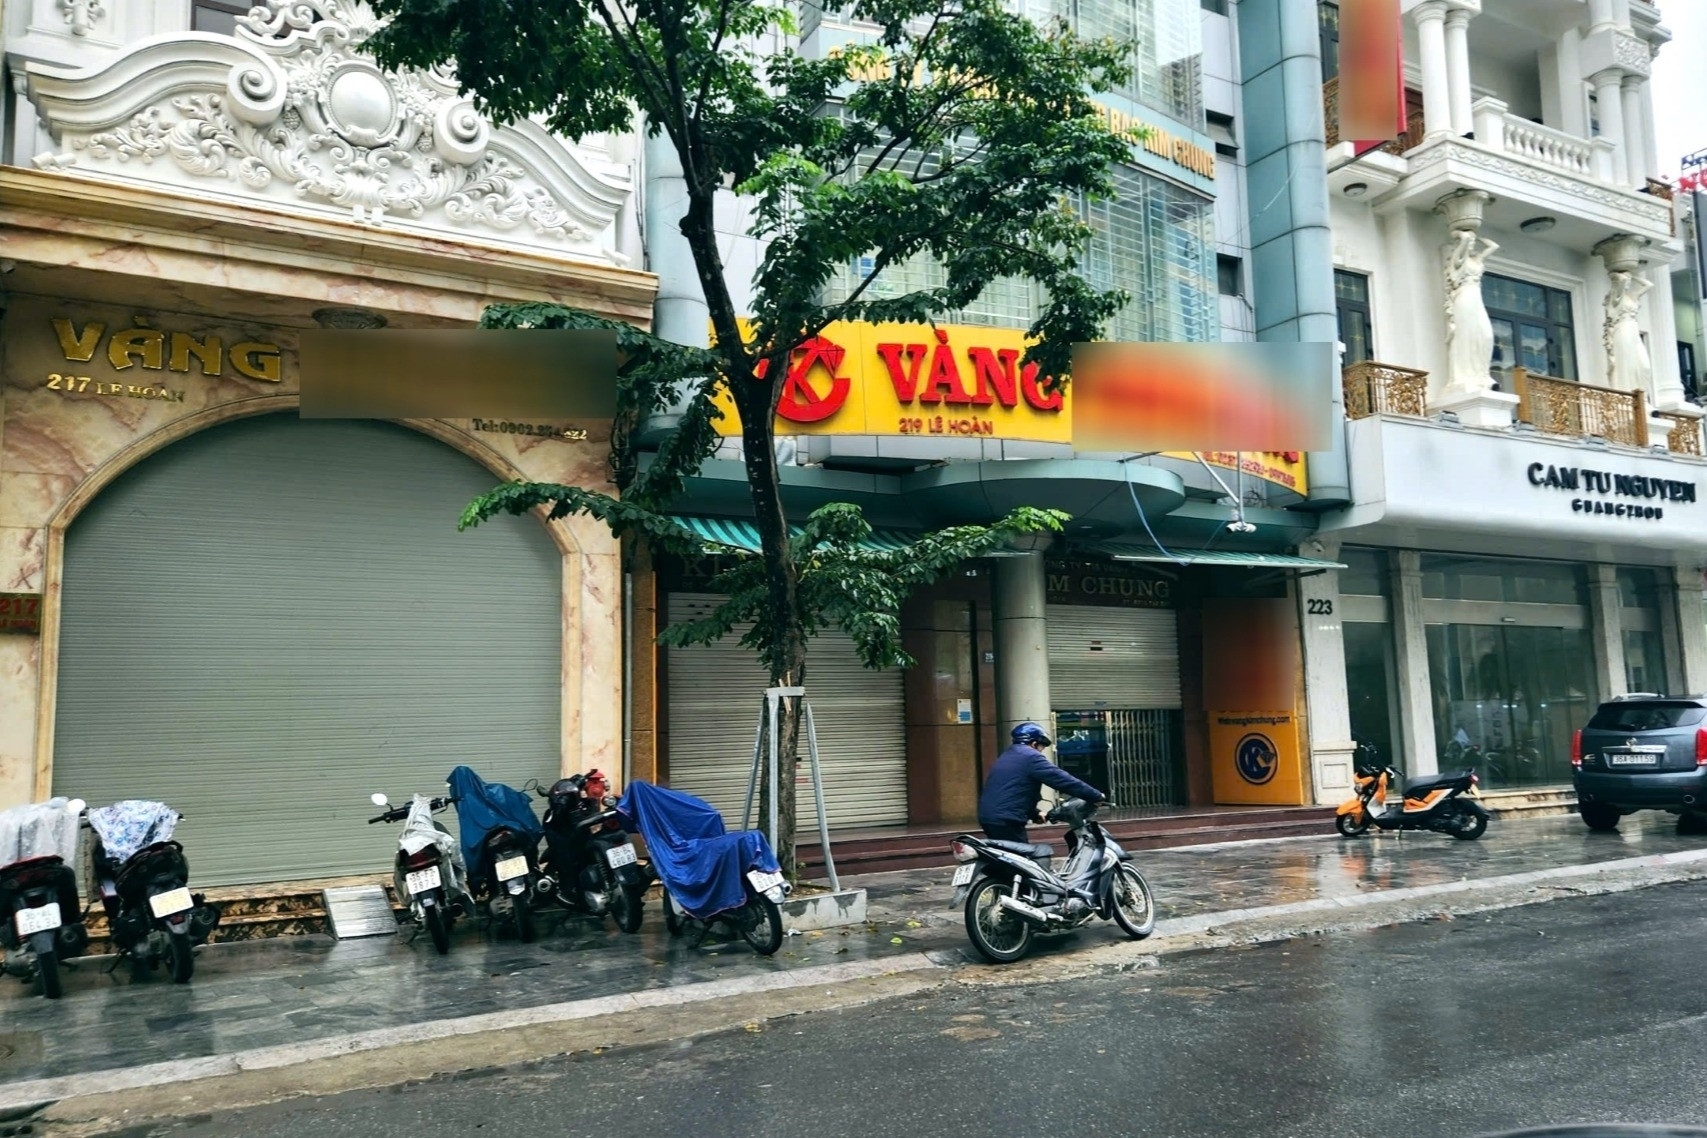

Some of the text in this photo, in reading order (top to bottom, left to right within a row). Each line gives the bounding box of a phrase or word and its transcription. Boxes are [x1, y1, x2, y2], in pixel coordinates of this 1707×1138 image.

[1173, 136, 1216, 181] CHUNG
[51, 315, 282, 383] VÀNG
[46, 373, 91, 392] 217
[877, 329, 1064, 413] VÀNG
[899, 416, 994, 435] 219 LÊ HOÀN
[1527, 461, 1697, 503] CAM TU NGUYEN
[1080, 576, 1170, 598] CHUNG
[1307, 598, 1333, 615] 223
